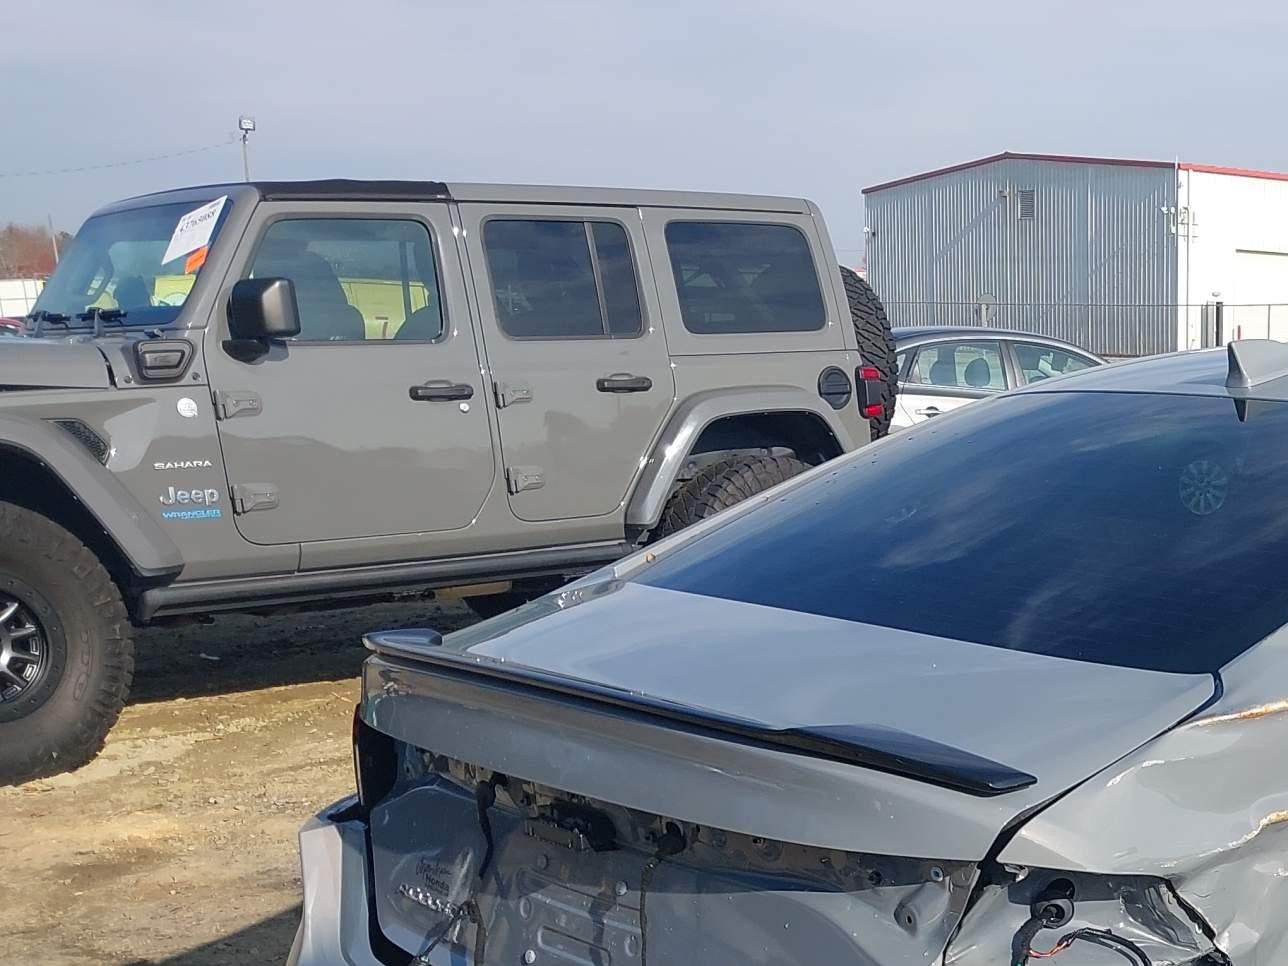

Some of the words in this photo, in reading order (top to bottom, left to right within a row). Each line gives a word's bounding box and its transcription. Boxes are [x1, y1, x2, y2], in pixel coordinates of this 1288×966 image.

[153, 460, 212, 470] SAHARA
[159, 486, 219, 506] Jeep
[162, 509, 221, 519] WRANGLER
